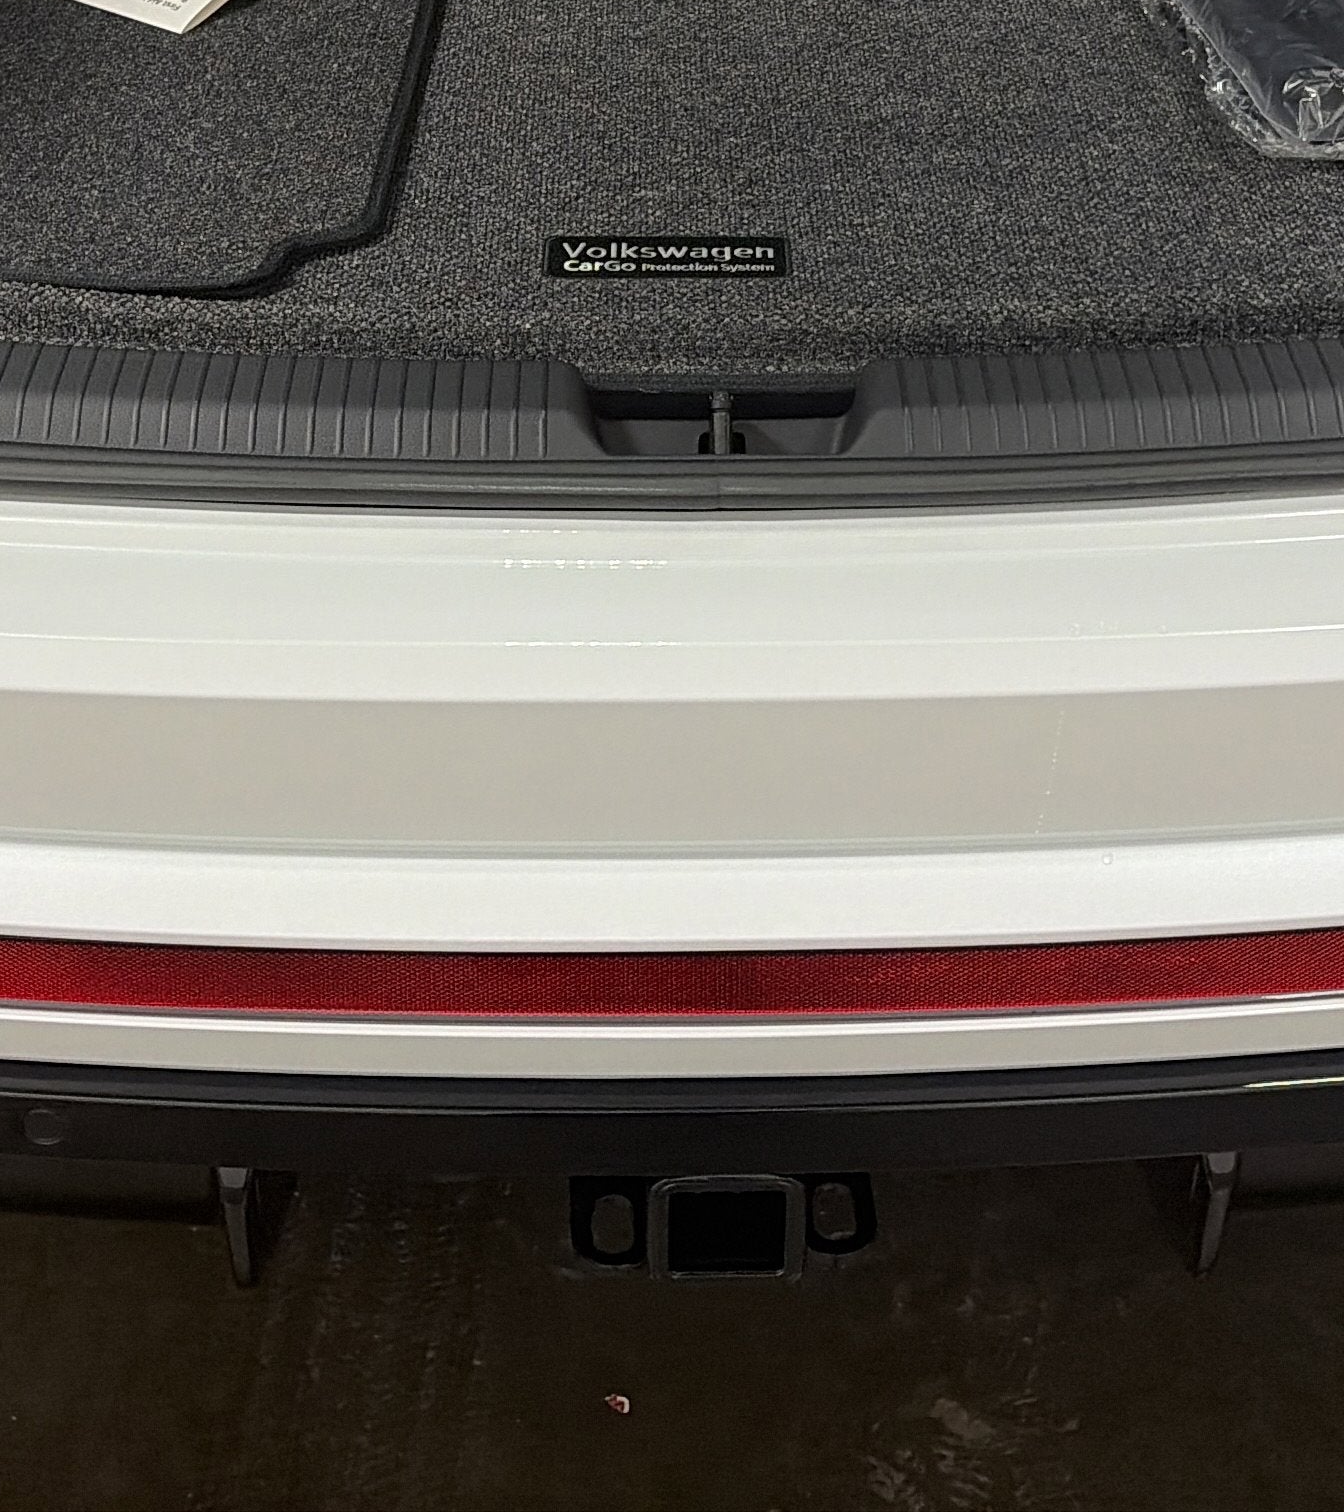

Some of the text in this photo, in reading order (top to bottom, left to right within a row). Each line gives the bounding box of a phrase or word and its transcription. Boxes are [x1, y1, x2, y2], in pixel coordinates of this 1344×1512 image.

[562, 242, 775, 262] Volkswagen
[563, 259, 775, 274] CarGo Protection System
